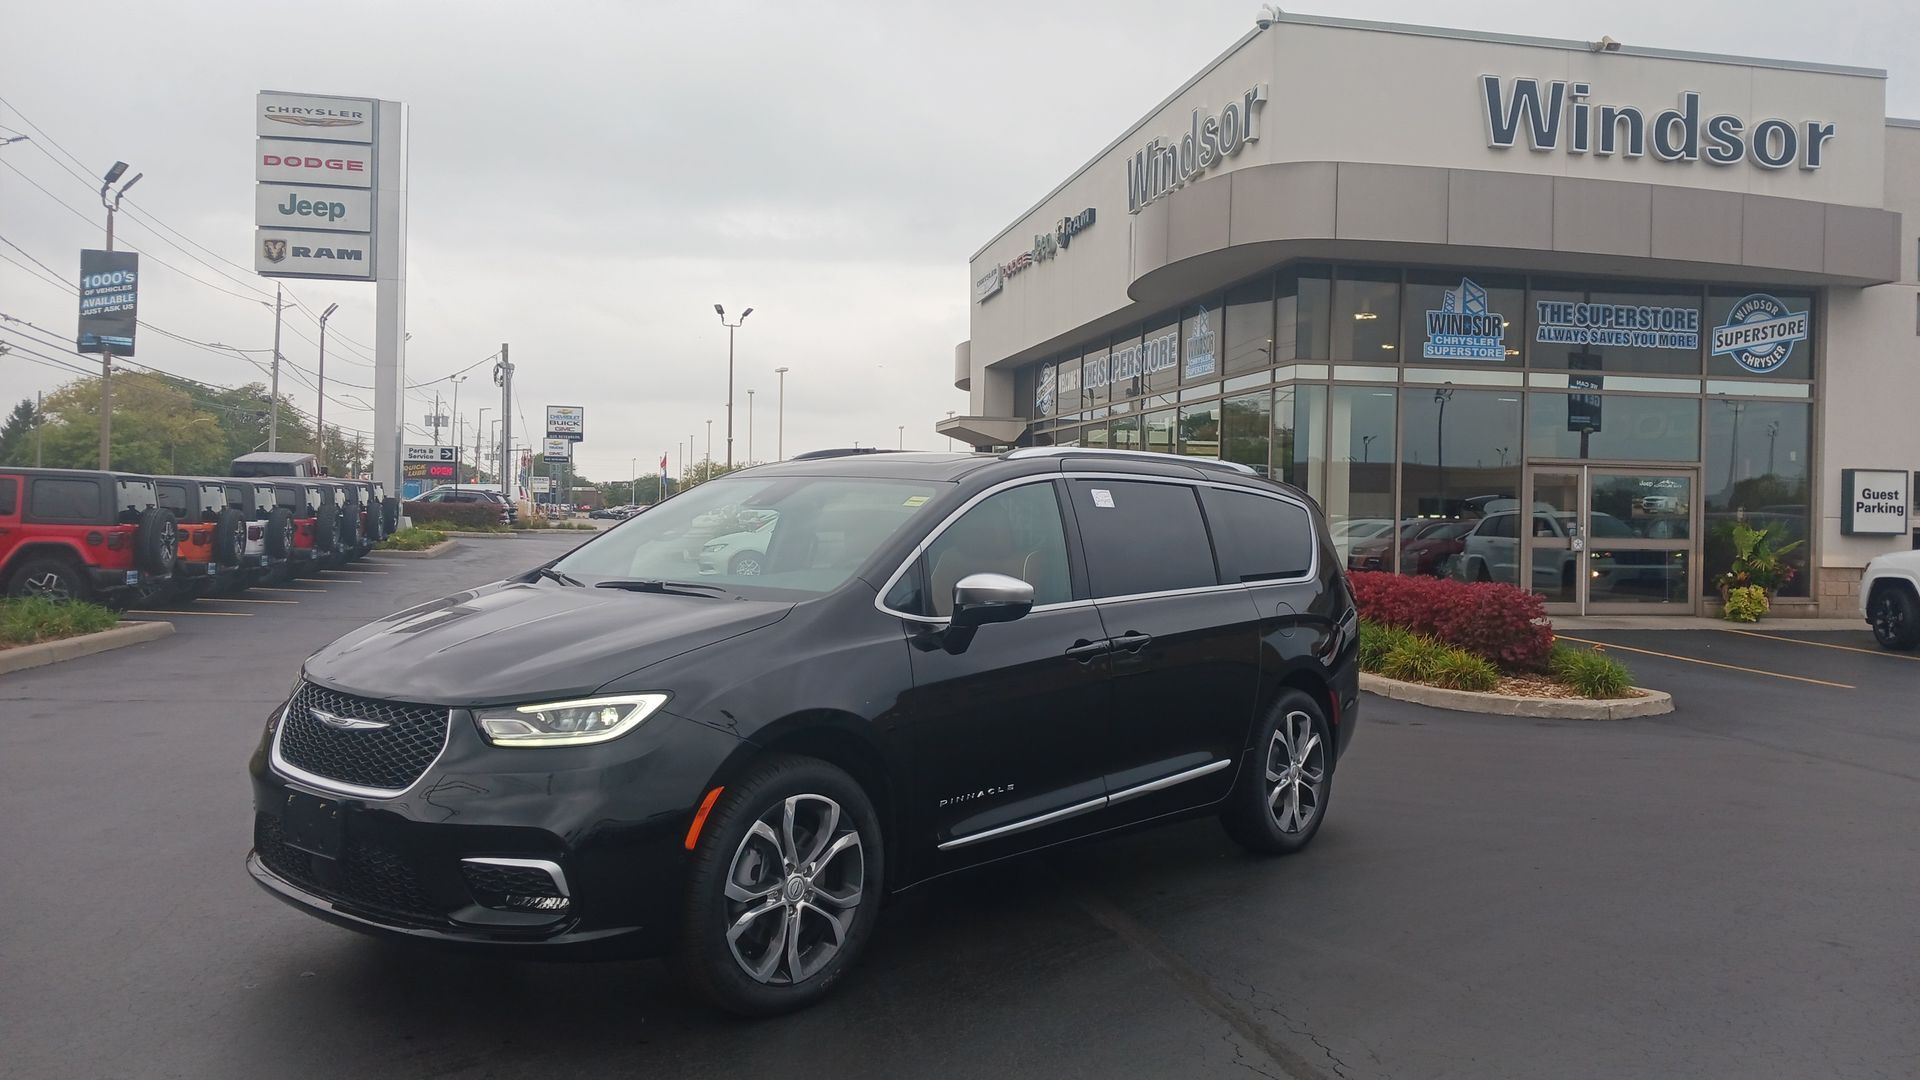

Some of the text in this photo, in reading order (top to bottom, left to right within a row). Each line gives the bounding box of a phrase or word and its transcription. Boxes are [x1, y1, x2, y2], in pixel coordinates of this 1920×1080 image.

[266, 105, 363, 119] CHRYSLER
[1479, 73, 1836, 172] Windsor
[1126, 83, 1269, 215] Windsor
[263, 154, 364, 172] DODGE
[278, 193, 346, 222] Jeep
[1066, 207, 1096, 236] RAM
[291, 246, 363, 261] RAM
[95, 285, 133, 294] VEHICLES
[81, 303, 134, 316] JUST ASK US
[82, 293, 135, 308] AVAILABLE
[1735, 299, 1779, 320] WINDSOR
[1428, 313, 1502, 336] WINDSOR
[1538, 301, 1698, 332] THE SUPERSTORE
[1435, 336, 1494, 346] CHRYSLER
[1537, 326, 1698, 349] ALWAYS SAVES YOU MORE!
[1716, 320, 1804, 348] SUPERSTORE
[1083, 363, 1096, 389] THE
[1098, 333, 1177, 387] SUPERSTORE
[1427, 345, 1503, 358] SUPERSTORE
[1742, 345, 1786, 368] CHRYSLER
[430, 466, 453, 476] OPEN
[1861, 487, 1900, 501] Guest
[1855, 501, 1905, 517] Parking
[939, 783, 1015, 808] PINNACLE
